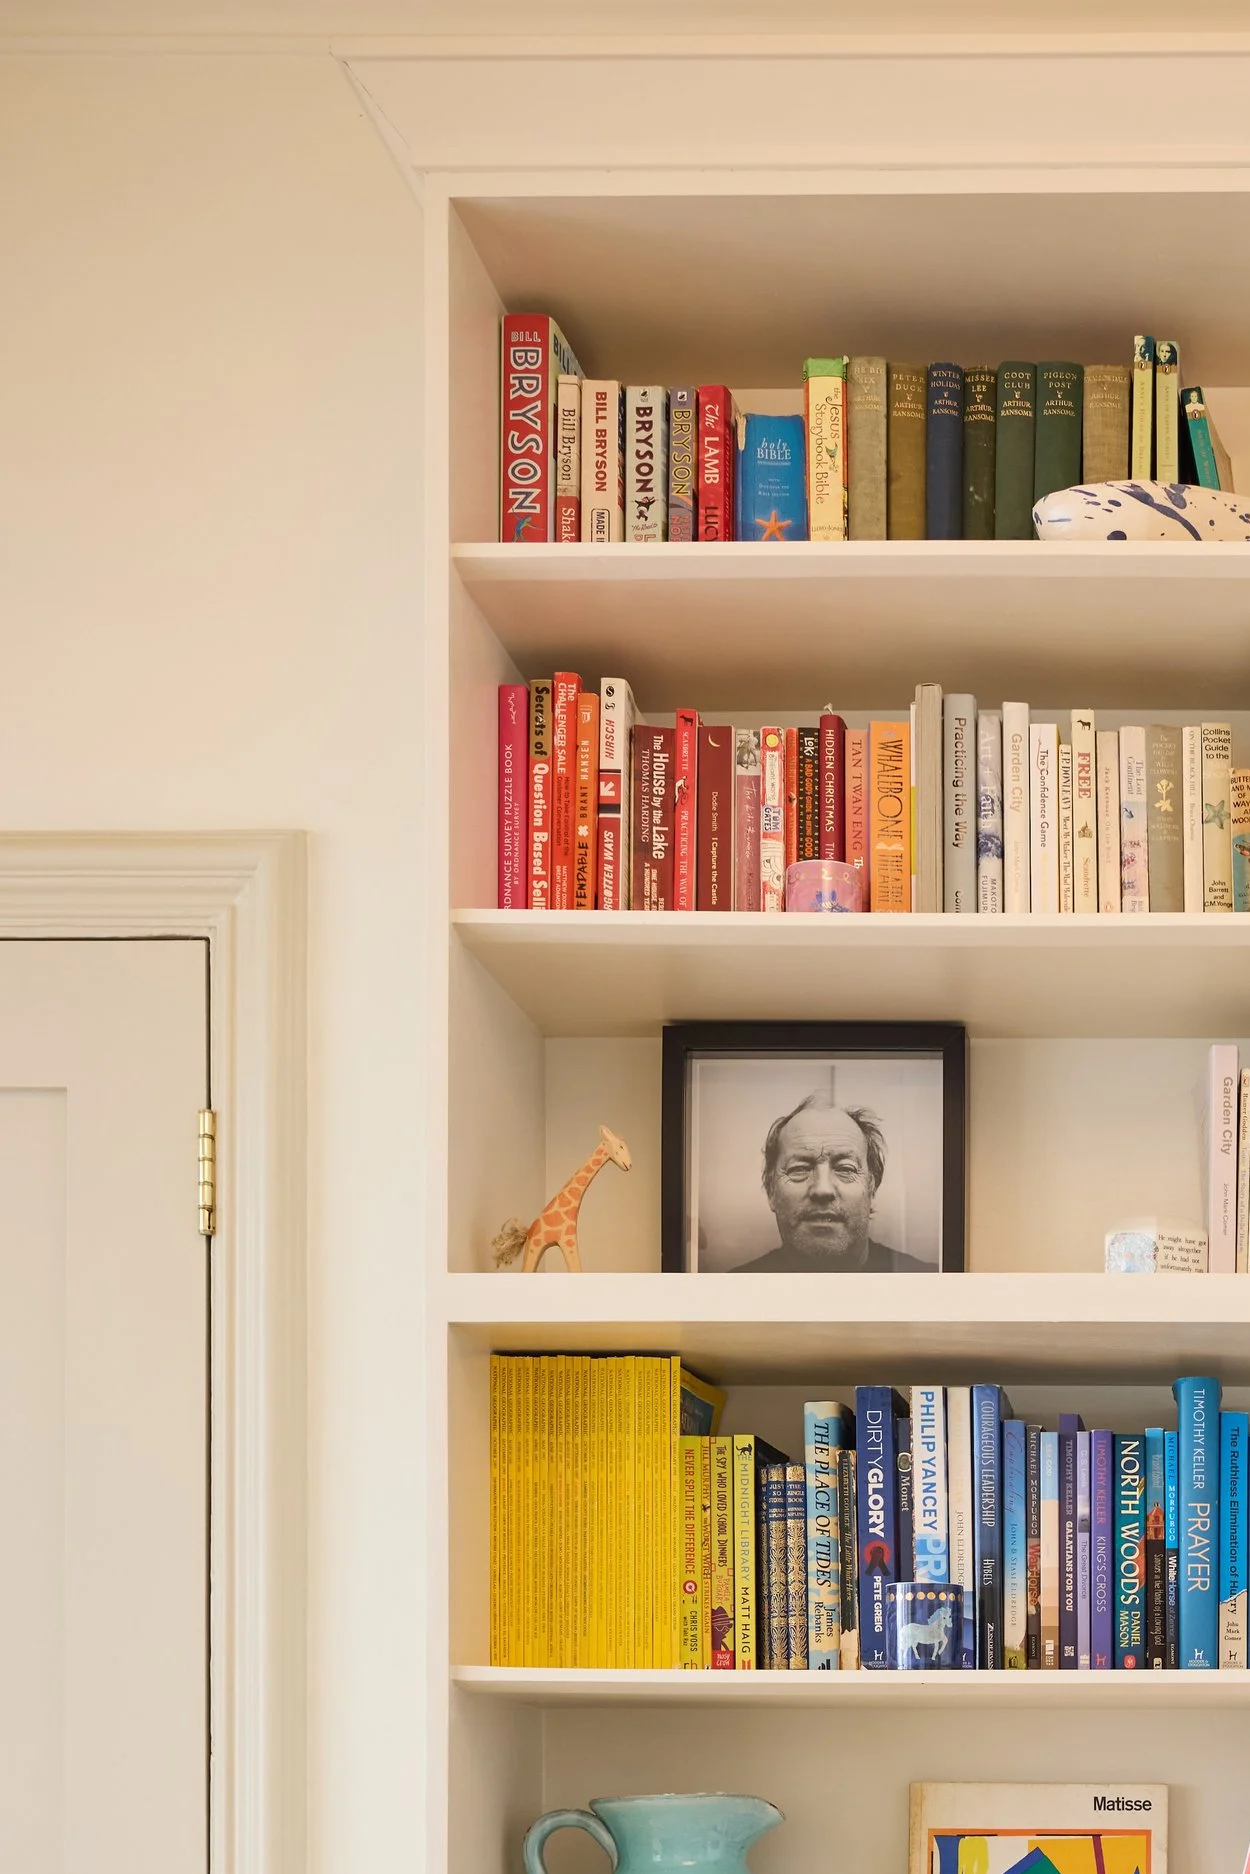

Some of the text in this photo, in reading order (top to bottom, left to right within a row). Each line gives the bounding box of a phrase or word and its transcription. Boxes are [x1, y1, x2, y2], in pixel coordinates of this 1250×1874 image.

[511, 332, 540, 342] BILL
[508, 347, 542, 512] BRYSON
[595, 392, 607, 492] BILL BRYSON
[636, 407, 653, 493] BRYSON
[672, 409, 691, 496] BRYSON
[704, 403, 720, 484] The LAMB
[757, 449, 791, 460] BIBLE
[810, 404, 825, 504] Storybook Bible
[605, 720, 615, 759] HIRSCH
[1078, 752, 1090, 798] FREE
[1203, 736, 1230, 744] Pocket
[1205, 744, 1228, 752] Guide
[652, 734, 669, 860] The House by the Lake
[901, 1475, 909, 1512] Monet
[921, 1391, 937, 1531] PHILIP YANCEY
[815, 1423, 830, 1587] THE PLACE OF TIDES
[1120, 1440, 1140, 1605] NORTH WOODS
[1188, 1503, 1210, 1592] PRAYER
[740, 1463, 750, 1652] MIDNIGHT LIBRARY MATT HAIG
[1093, 1797, 1152, 1812] Matisse
